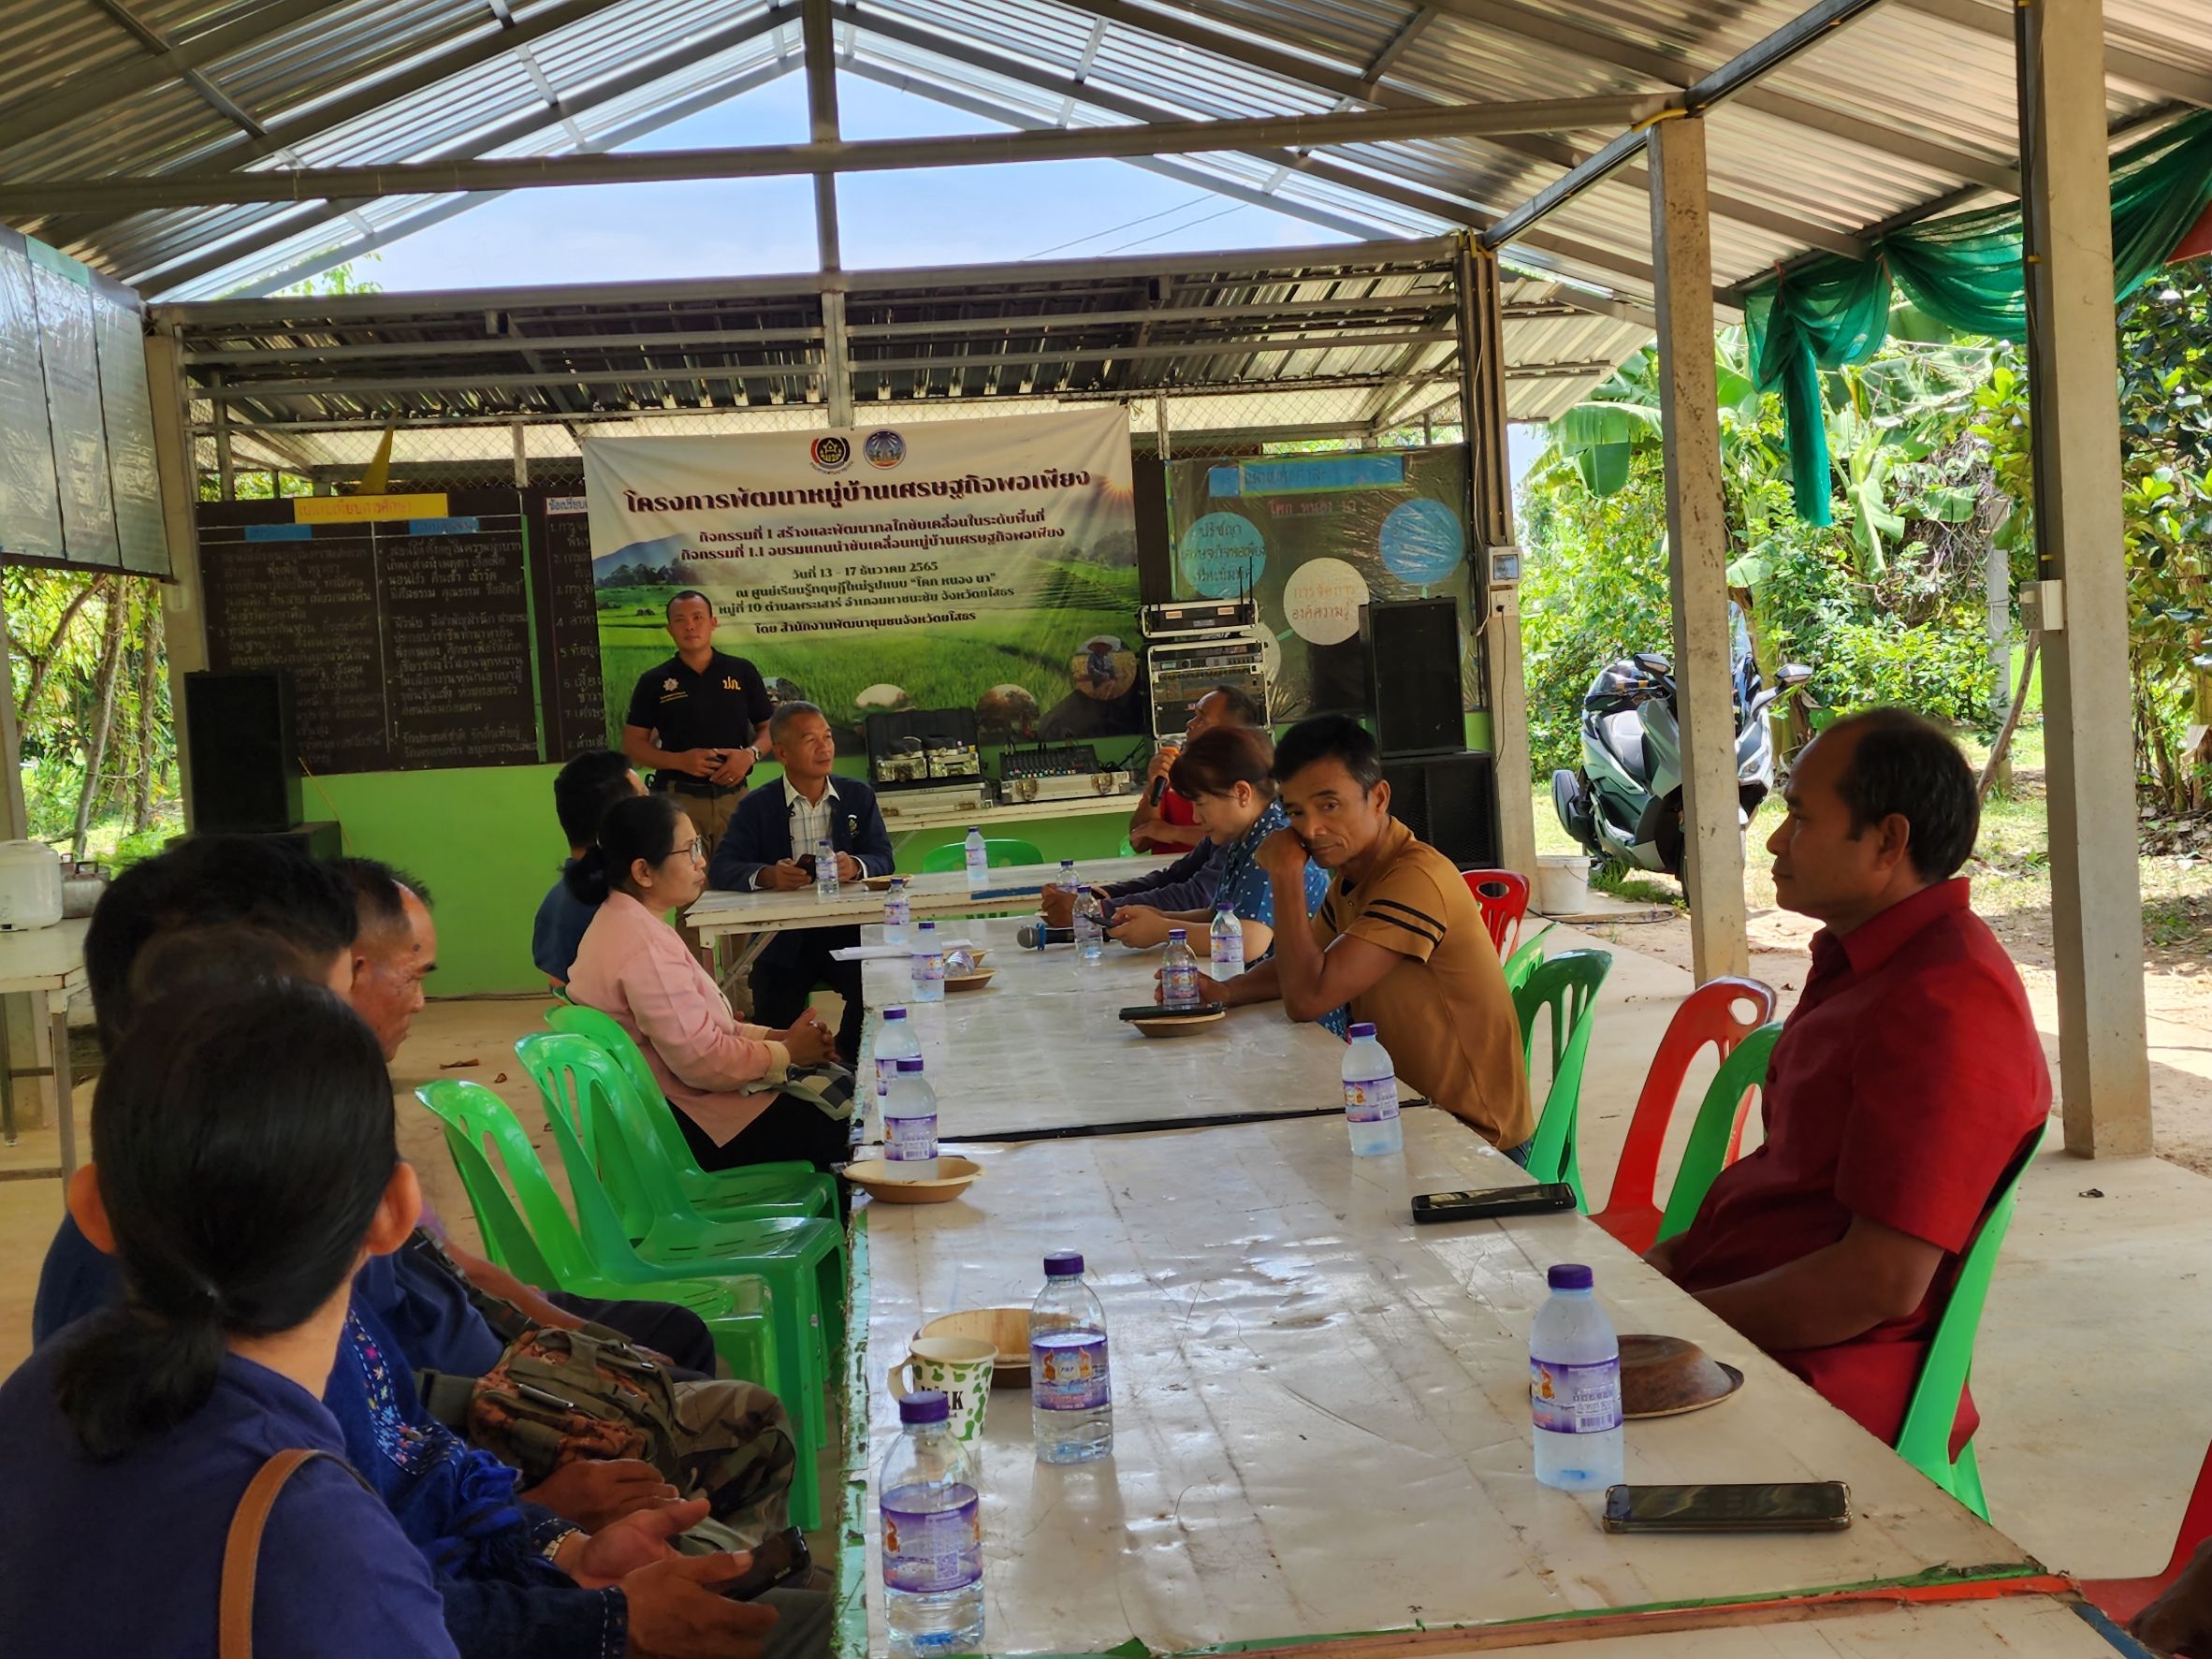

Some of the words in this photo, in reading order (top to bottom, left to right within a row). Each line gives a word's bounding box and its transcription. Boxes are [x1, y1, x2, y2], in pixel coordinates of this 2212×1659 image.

[624, 469, 1091, 514] โครงการพัฒนาหมู่บ้านเศรษฐกิจพอเพียง
[699, 525, 763, 543] กิจกรรมที่
[767, 529, 773, 539] 1
[681, 543, 745, 560] กิจกรรมที่
[749, 546, 764, 558] 1.1
[793, 565, 817, 580] วันที่
[821, 568, 833, 577] 13
[845, 566, 857, 576] 17
[860, 564, 906, 575] ธันวาคม
[909, 561, 939, 573] 2565
[719, 598, 744, 617] หมู่ที่
[749, 603, 762, 613] 10
[755, 622, 778, 634] โดย
